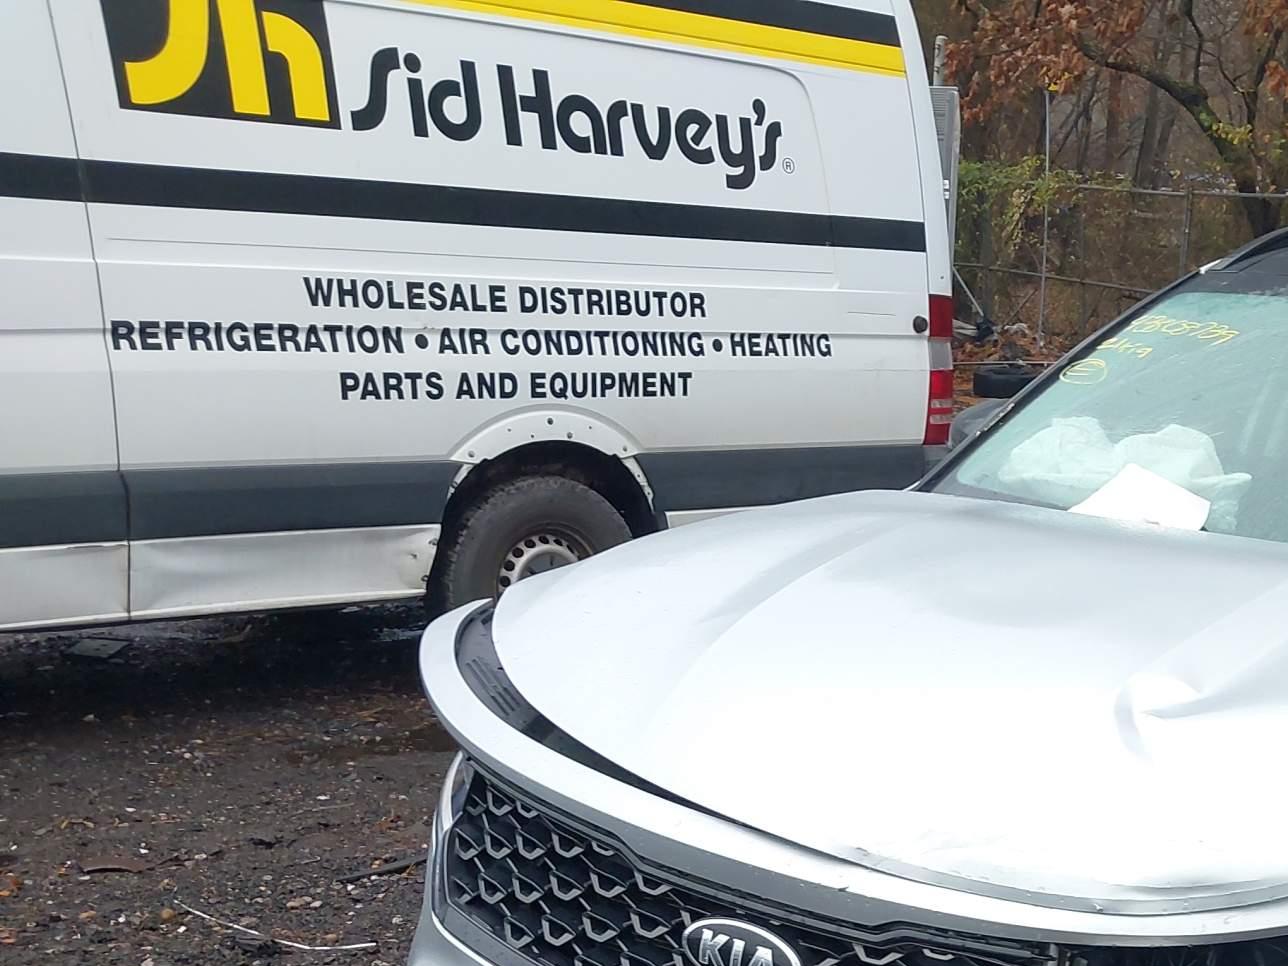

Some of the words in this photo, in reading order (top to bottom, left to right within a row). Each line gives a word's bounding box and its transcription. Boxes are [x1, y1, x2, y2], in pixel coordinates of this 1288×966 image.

[350, 46, 483, 142] Sid
[496, 63, 783, 190] Harvey's
[302, 276, 508, 313] WHOLESALE
[518, 285, 707, 318] DISTRIBUTOR
[110, 319, 405, 354] REFRIGERATION
[438, 327, 491, 355] AIR
[500, 328, 705, 357] CONDITIONING
[730, 332, 833, 358] HEATING
[339, 371, 445, 400] PARTS
[455, 371, 518, 400] AND
[530, 371, 693, 400] EQUIPMENT
